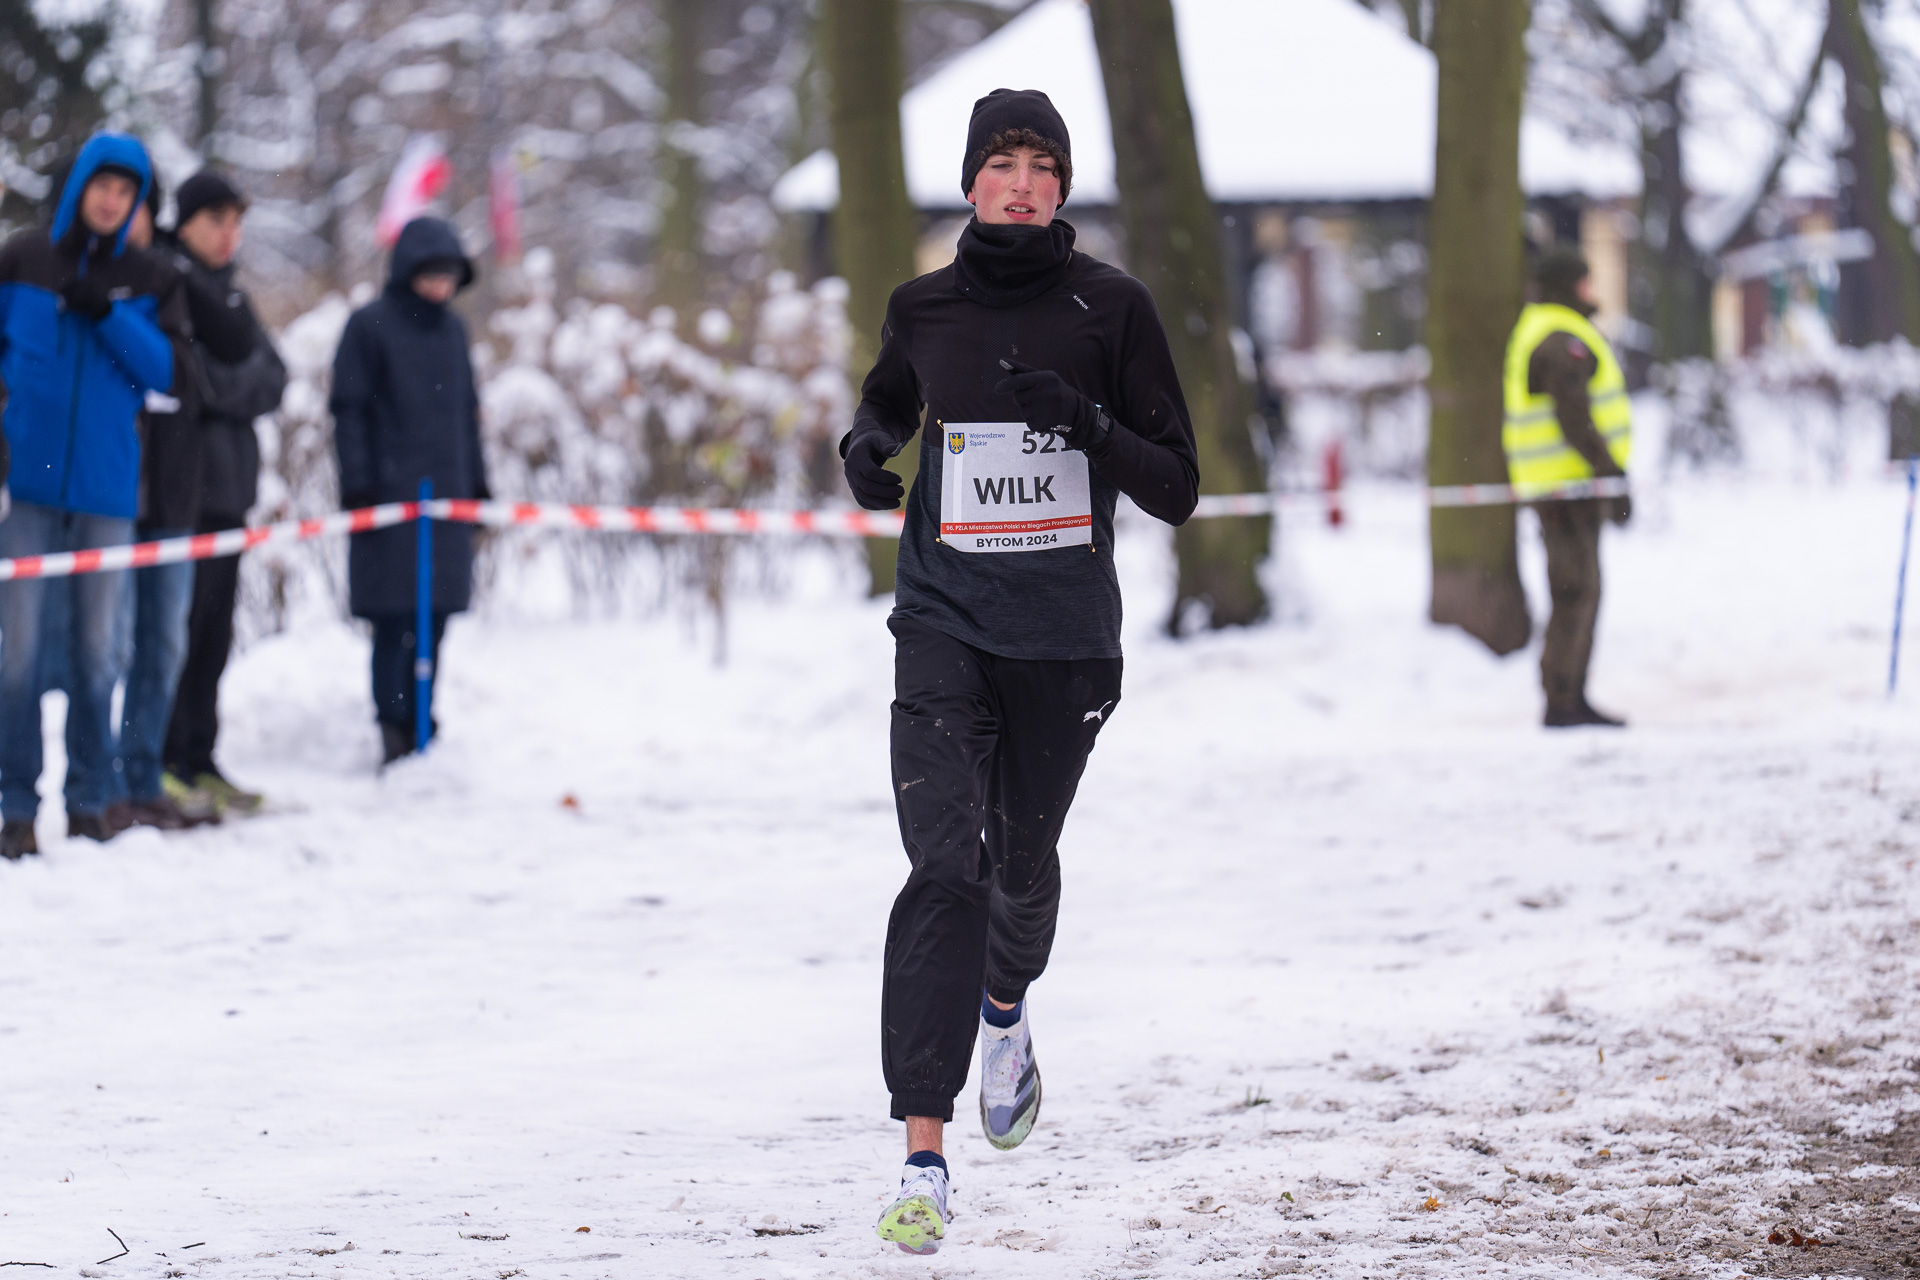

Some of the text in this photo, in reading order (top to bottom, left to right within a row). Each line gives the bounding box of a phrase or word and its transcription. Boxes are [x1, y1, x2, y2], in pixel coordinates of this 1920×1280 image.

[968, 432, 1006, 440] Województwo
[973, 475, 1057, 505] WILK
[1027, 521, 1051, 530] Biegach
[976, 533, 1058, 548] BYTOM 2024
